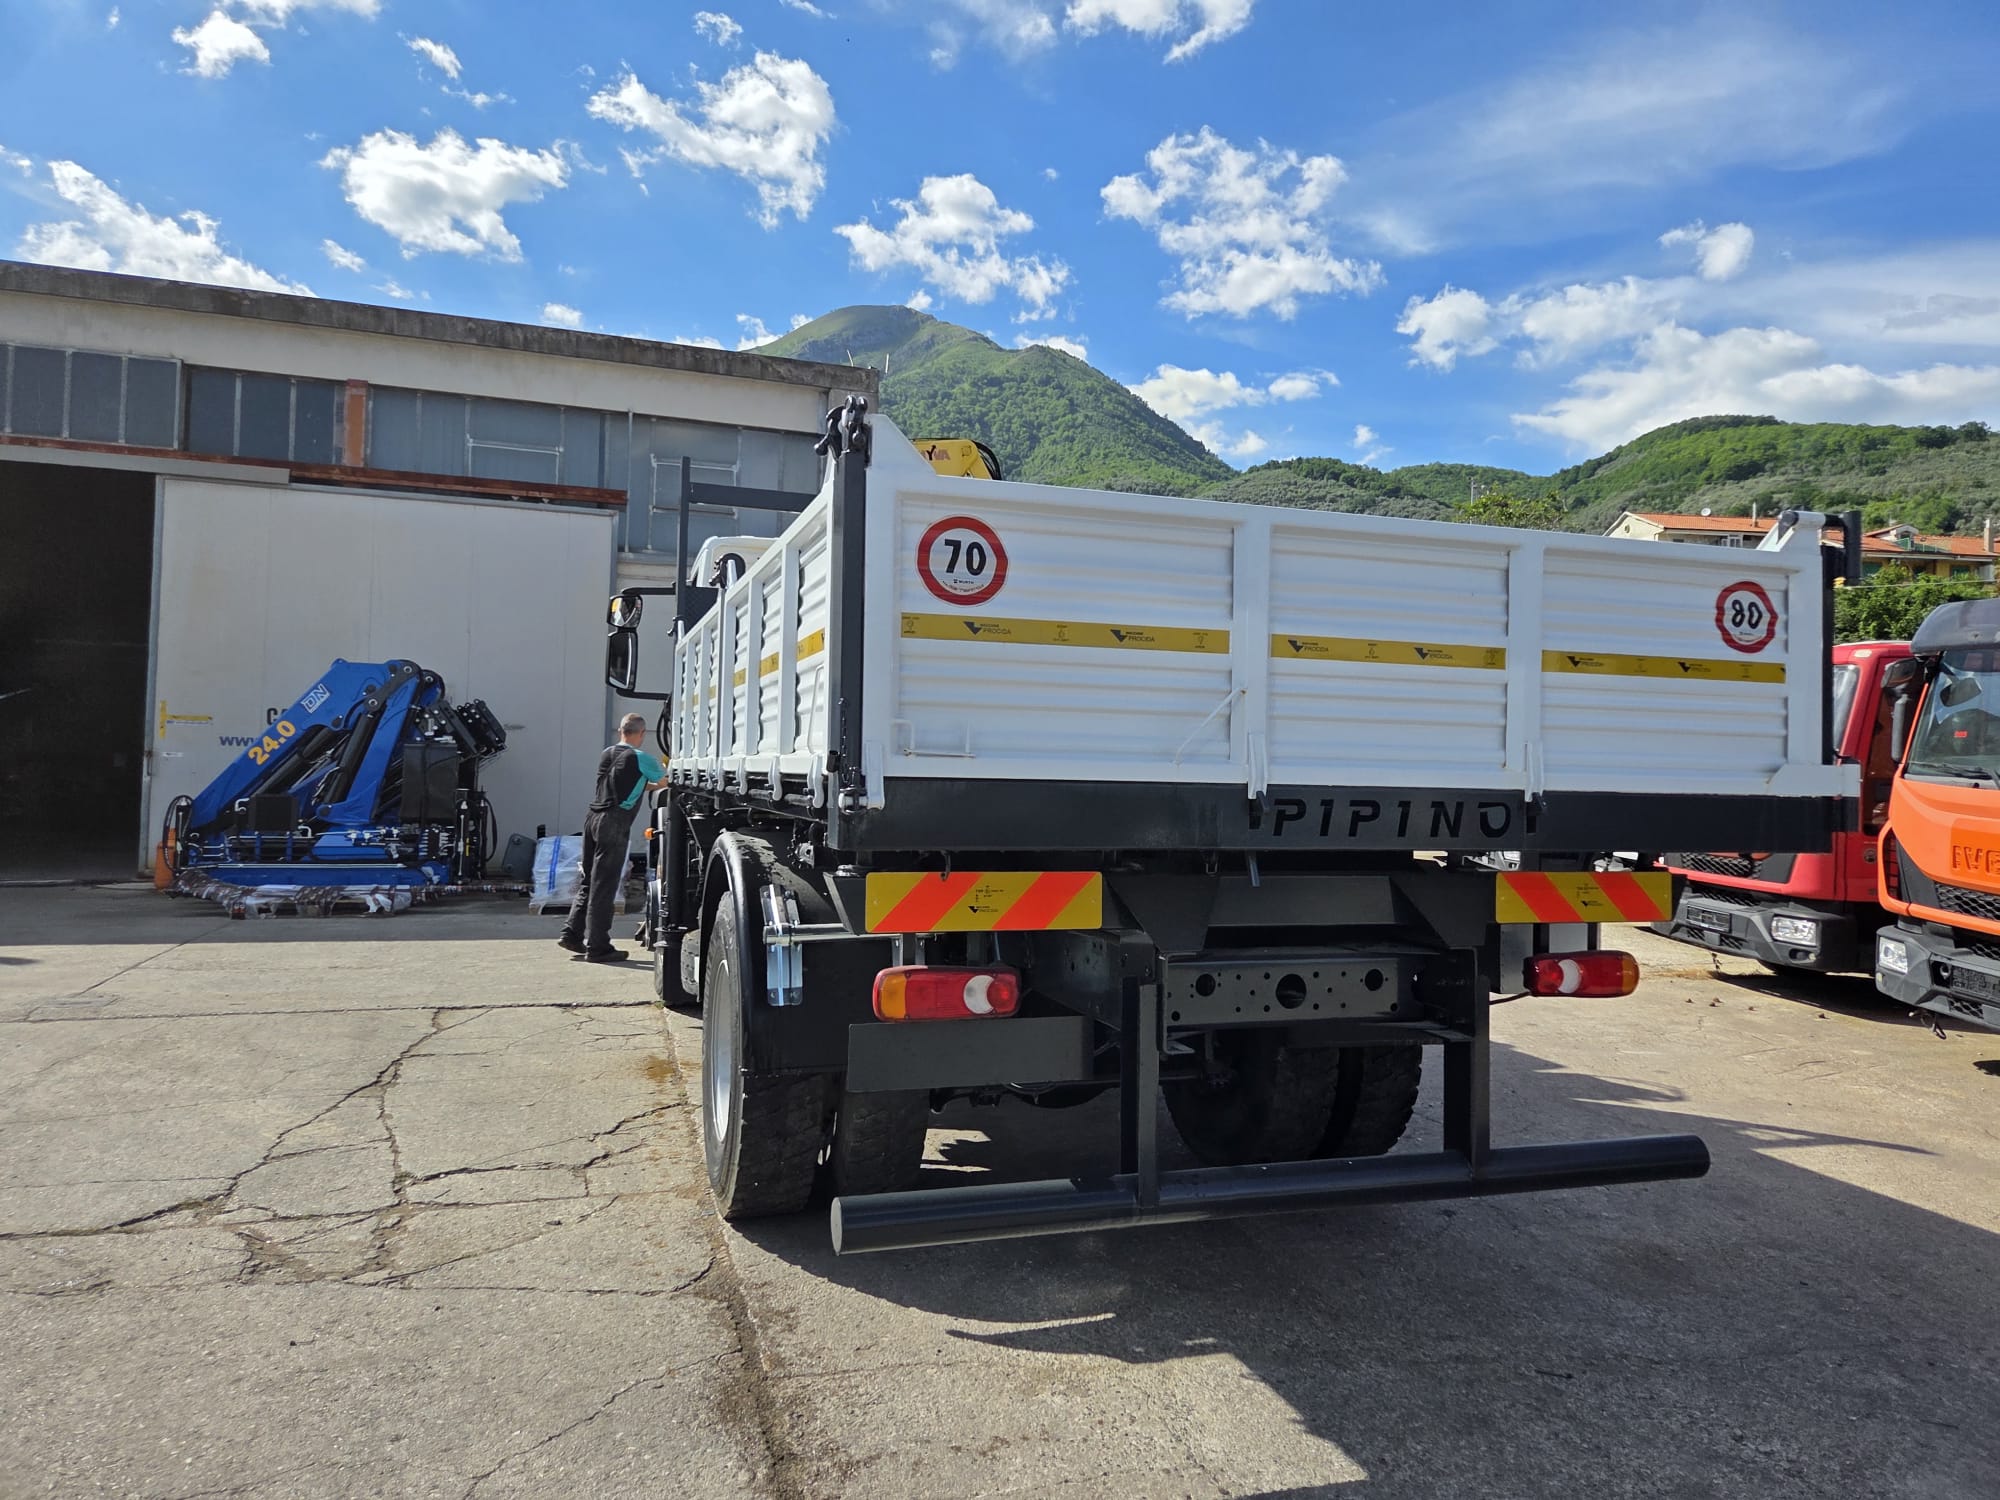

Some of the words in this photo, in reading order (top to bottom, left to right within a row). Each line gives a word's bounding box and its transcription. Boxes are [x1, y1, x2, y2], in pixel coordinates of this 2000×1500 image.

[944, 538, 987, 576] 70
[1731, 599, 1763, 629] 80
[248, 720, 296, 766] 24.0
[1272, 798, 1512, 838] PIPINO
